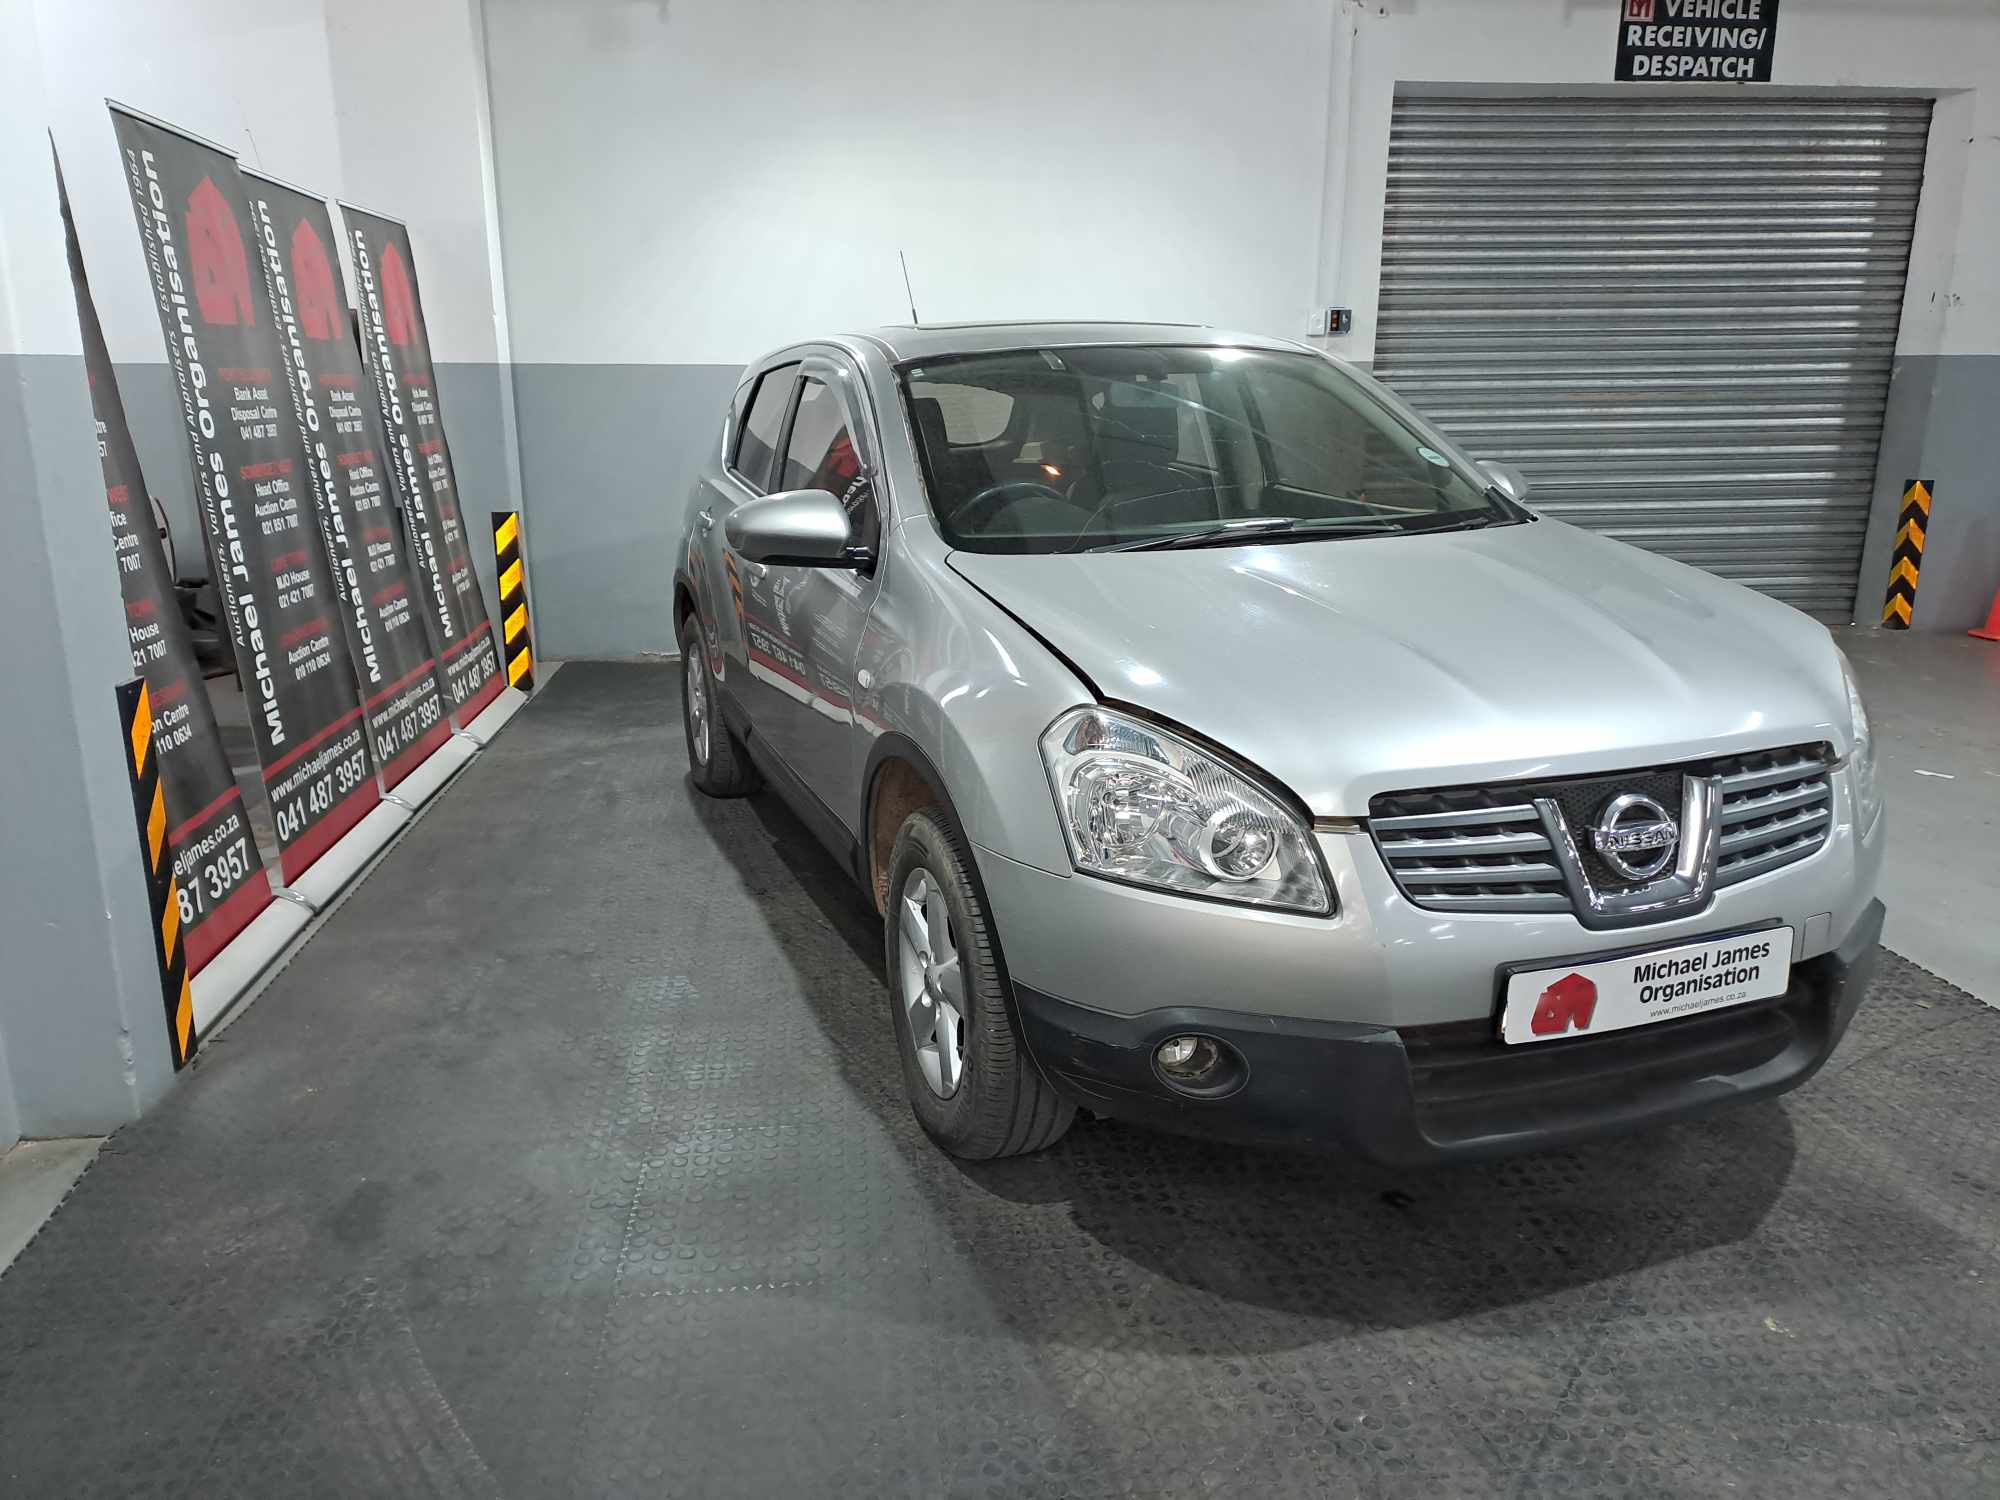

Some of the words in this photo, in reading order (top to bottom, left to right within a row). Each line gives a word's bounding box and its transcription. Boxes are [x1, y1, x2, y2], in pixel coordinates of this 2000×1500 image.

[1665, 0, 1762, 20] VEHICLE
[1627, 24, 1768, 50] RECEIVING/
[1632, 54, 1755, 78] DESPATCH
[126, 147, 144, 197] 1964
[137, 201, 171, 313] Established
[142, 150, 215, 439] Organisation
[257, 200, 320, 432] Organisation
[355, 230, 403, 424] Organisation
[168, 330, 196, 428] Appraisers
[233, 386, 252, 401] Bank
[281, 343, 304, 422] Appraisers
[370, 351, 390, 417] Appraisers
[189, 430, 205, 466] and
[297, 424, 312, 454] and
[384, 419, 396, 444] and
[307, 458, 325, 510] Valuers
[392, 447, 407, 491] Valuers
[399, 434, 427, 524] James
[200, 471, 220, 535] Valuers
[209, 452, 249, 582] James
[315, 442, 349, 549] James
[112, 533, 139, 551] Centre
[120, 553, 141, 573] 7007
[322, 516, 348, 602] Auctioneers,
[217, 542, 246, 648] Auctioneers,
[420, 531, 454, 638] Michael
[129, 622, 160, 644] House
[341, 558, 382, 684] Michael
[147, 639, 167, 661] 7007
[239, 594, 286, 746] Michael
[163, 703, 190, 726] Centre
[452, 675, 469, 704] 041
[174, 723, 193, 747] 0634
[377, 726, 400, 761] 041
[401, 710, 419, 743] 487
[418, 694, 441, 729] 3957
[271, 729, 361, 802] www.michaeljames.co.za
[277, 796, 307, 841] 041
[309, 773, 333, 814] 487
[336, 749, 366, 793] 3957
[1608, 824, 1676, 849] NISSAN
[204, 837, 250, 900] 3957
[1633, 951, 1709, 984] Michael
[1711, 941, 1771, 968] James
[1639, 965, 1760, 1004] Organisation
[1649, 990, 1747, 1018] www.michaeljames.co.za
